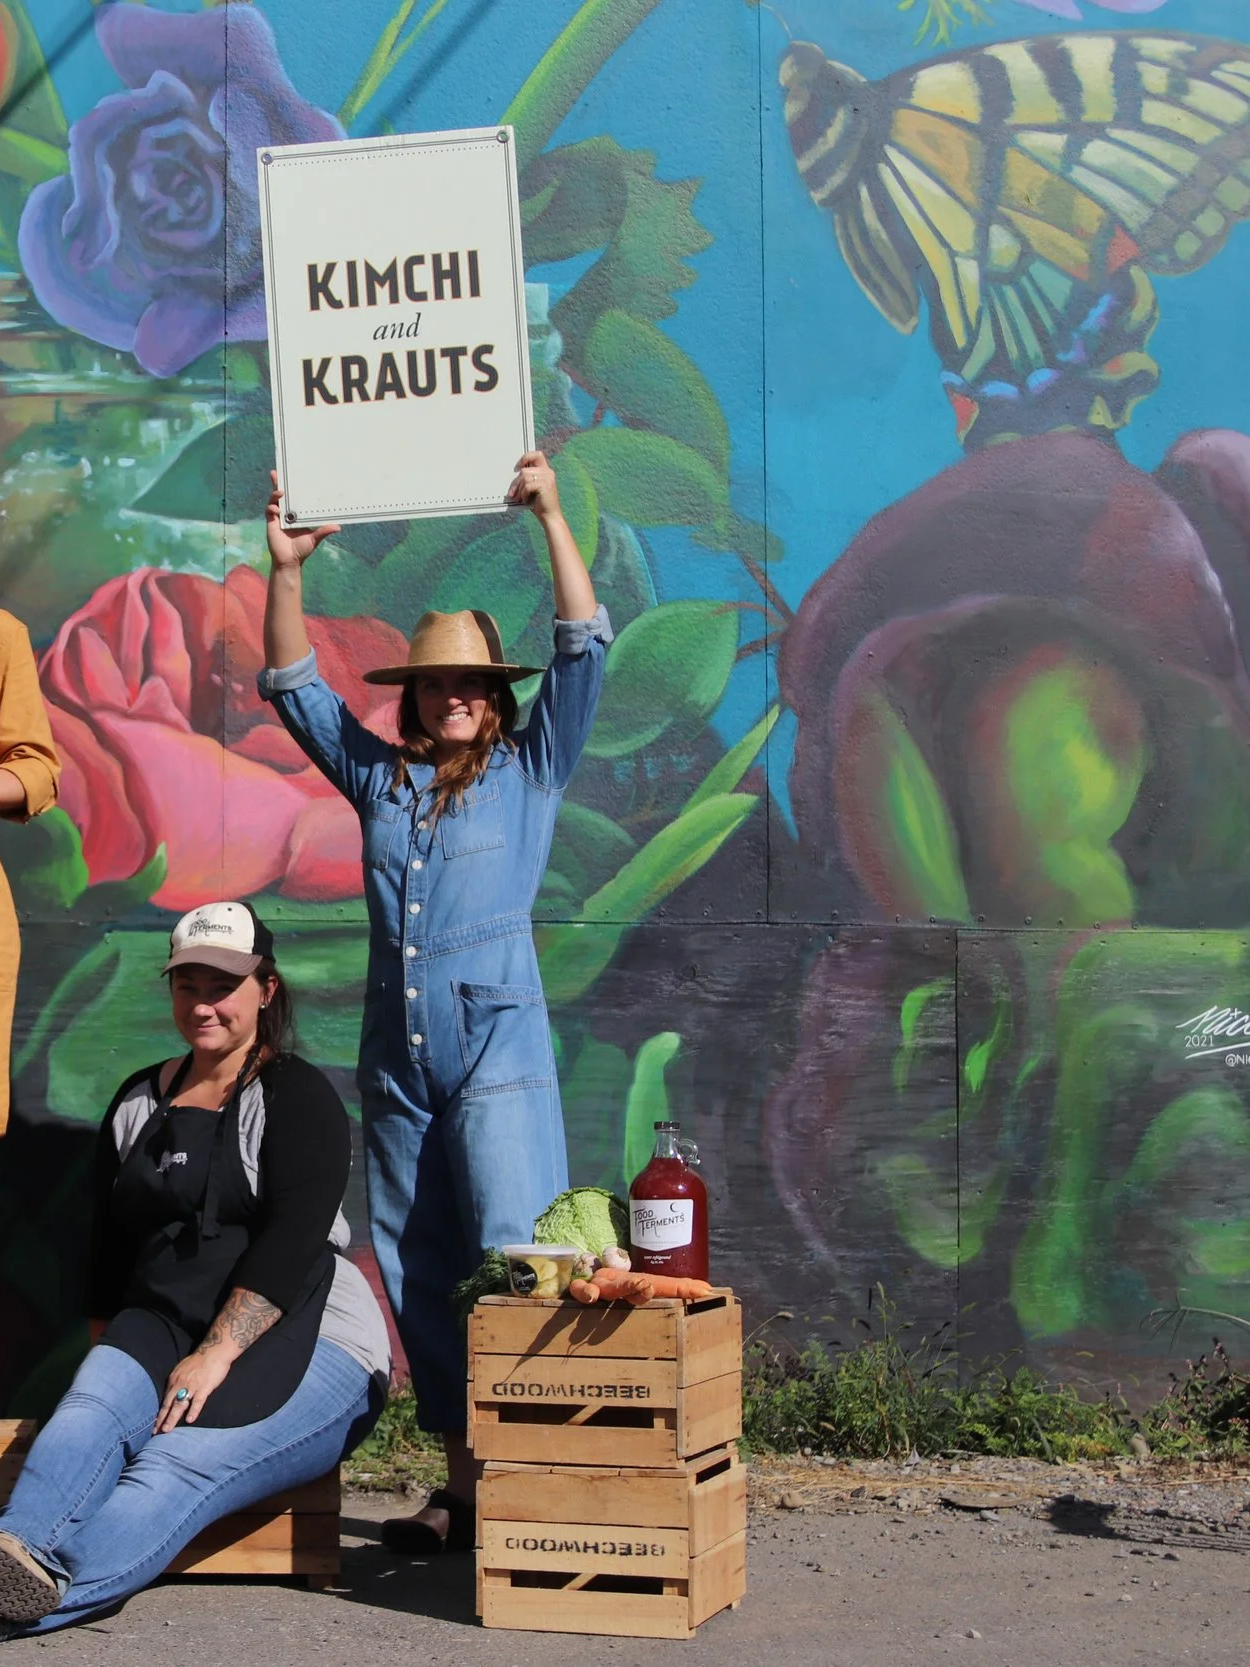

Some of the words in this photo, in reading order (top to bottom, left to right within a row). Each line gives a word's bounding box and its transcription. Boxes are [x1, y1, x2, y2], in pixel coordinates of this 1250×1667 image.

[307, 249, 481, 311] KIMCHI
[372, 312, 422, 341] and
[302, 344, 499, 407] KRAUTS
[1184, 1034, 1214, 1048] 2021
[491, 1382, 651, 1400] BEECHWOOD
[505, 1537, 666, 1558] BEECHWOOD
